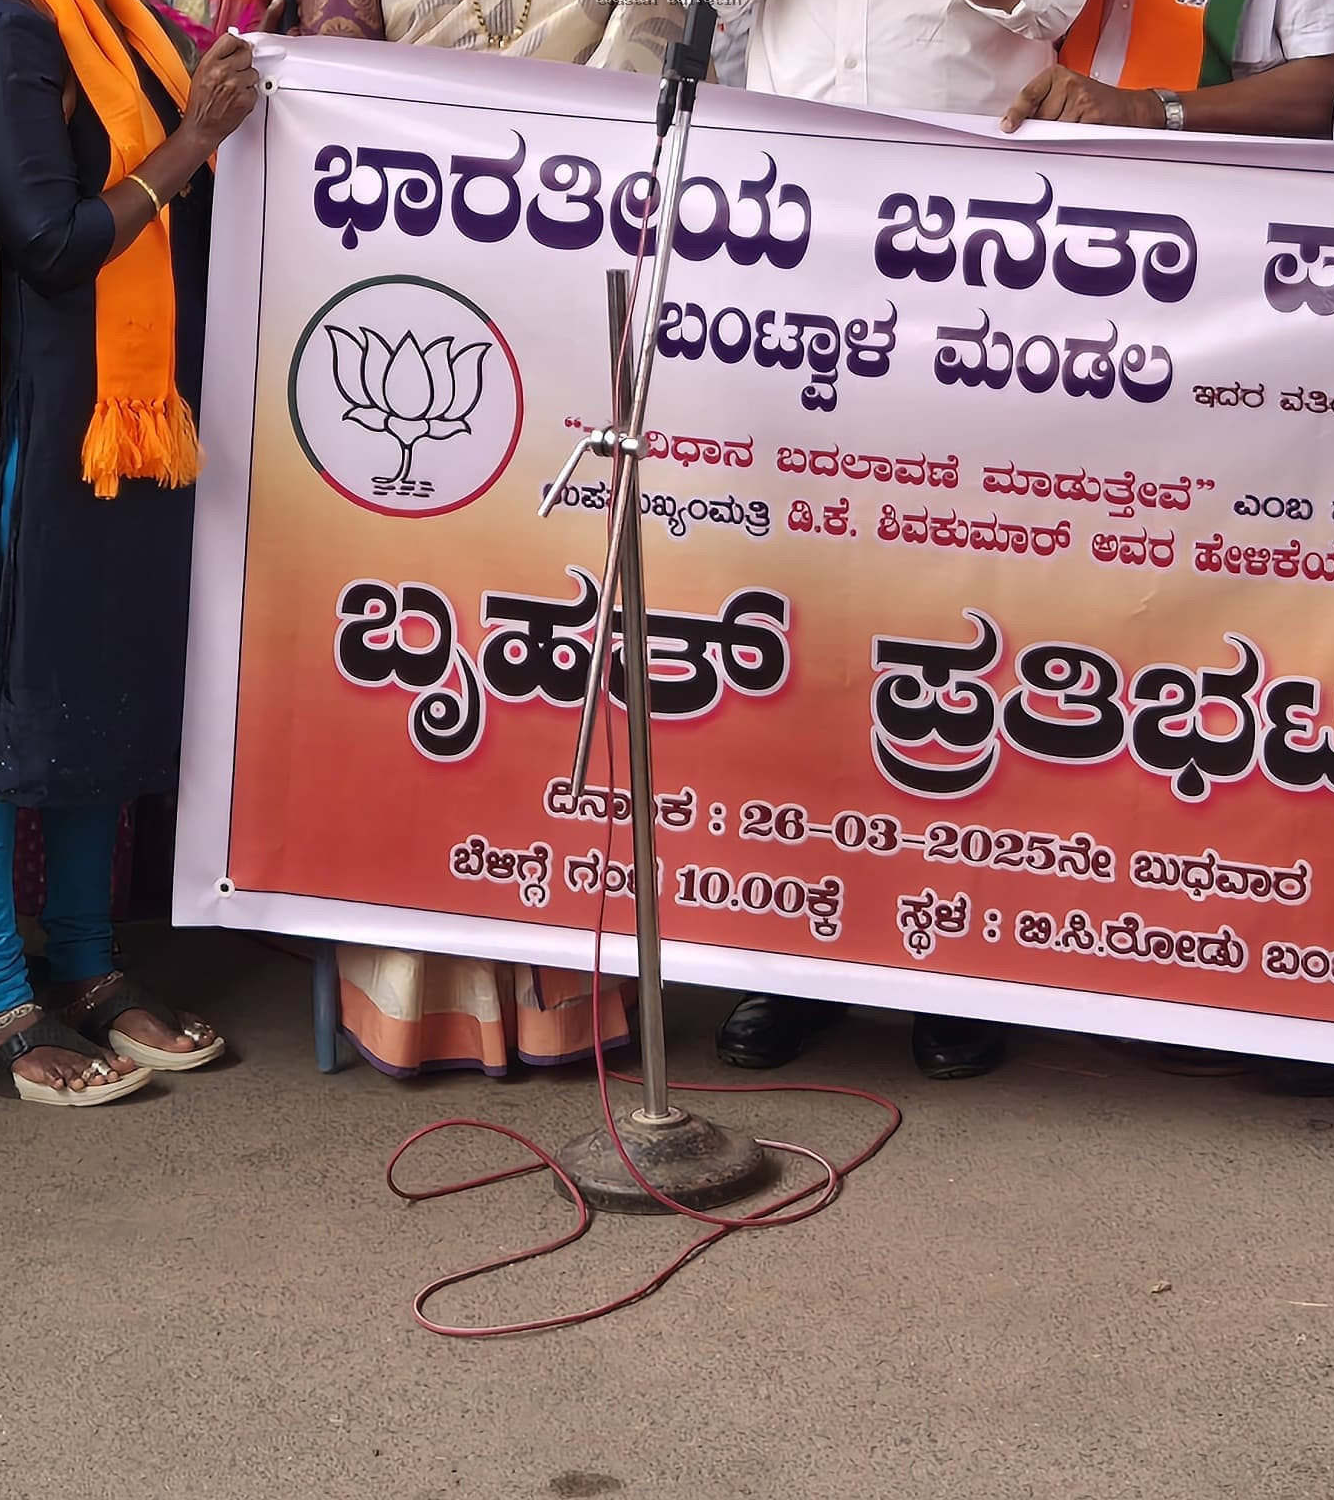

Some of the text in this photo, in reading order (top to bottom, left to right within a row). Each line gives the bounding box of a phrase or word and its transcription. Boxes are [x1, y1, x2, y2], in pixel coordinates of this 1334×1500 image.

[314, 128, 811, 270] ಭಾರತೀಯ
[873, 172, 1198, 304] ಜನತಾ
[657, 298, 898, 412] ಬಂಟ್ವಾಳ
[933, 307, 1174, 404] ಮಂಡಲ
[1191, 382, 1266, 410] ಇದರ
[777, 442, 961, 490] ಬದಲಾವಣೆ
[1233, 492, 1314, 522] ಎಂಬ
[876, 503, 1071, 557] ಶಿವಕುಮಾರ್
[1090, 525, 1176, 569] ಅವರ
[451, 834, 553, 907] ಬೆಳಿಗ್ಗೆ
[897, 889, 971, 959] ಸ್ಥಳ
[546, 778, 696, 829] ದಿನಾಕ
[1130, 850, 1311, 903] ಬುಧವಾರ
